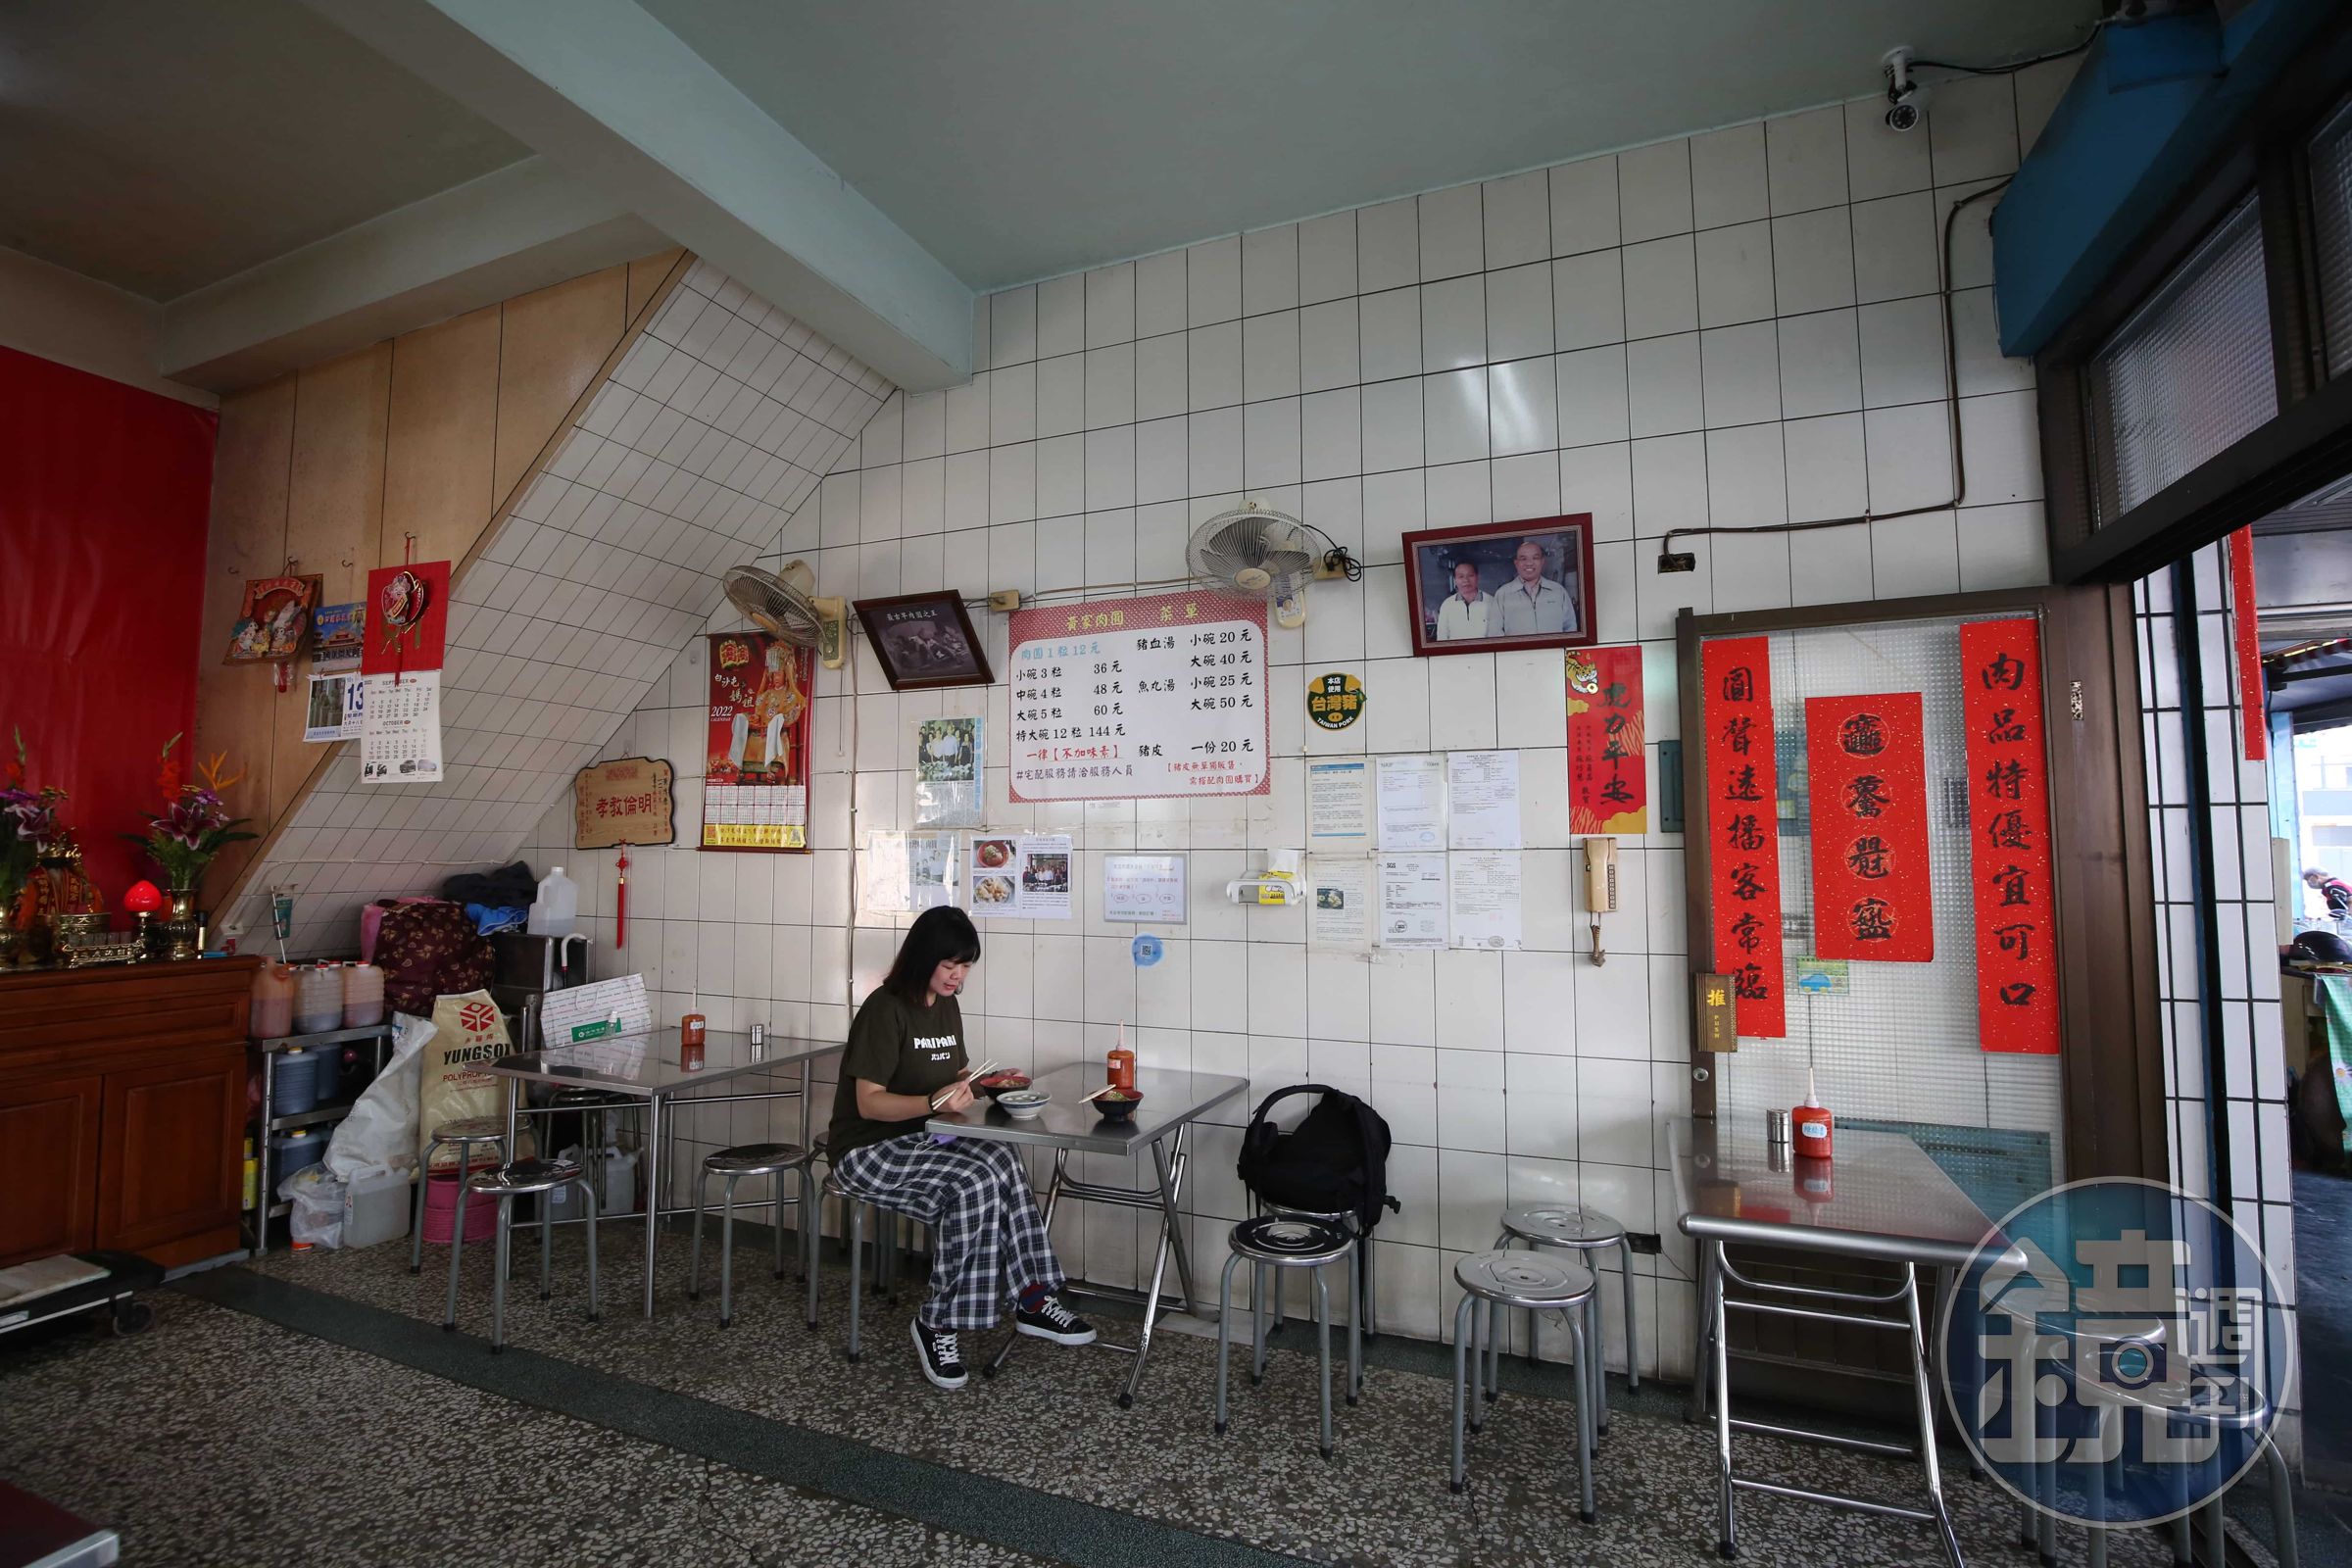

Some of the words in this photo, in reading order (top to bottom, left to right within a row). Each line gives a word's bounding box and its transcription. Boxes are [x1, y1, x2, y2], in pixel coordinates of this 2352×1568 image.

[1136, 636, 1176, 651] 豬血湯
[1138, 678, 1176, 693] 魚丸湯
[1311, 694, 1357, 712] 台灣豬
[710, 706, 733, 717] 2022
[1317, 717, 1339, 728] TAIWAN
[1338, 715, 1354, 727] PORK
[1139, 743, 1164, 758] 豬皮
[1707, 989, 1726, 1007] 推
